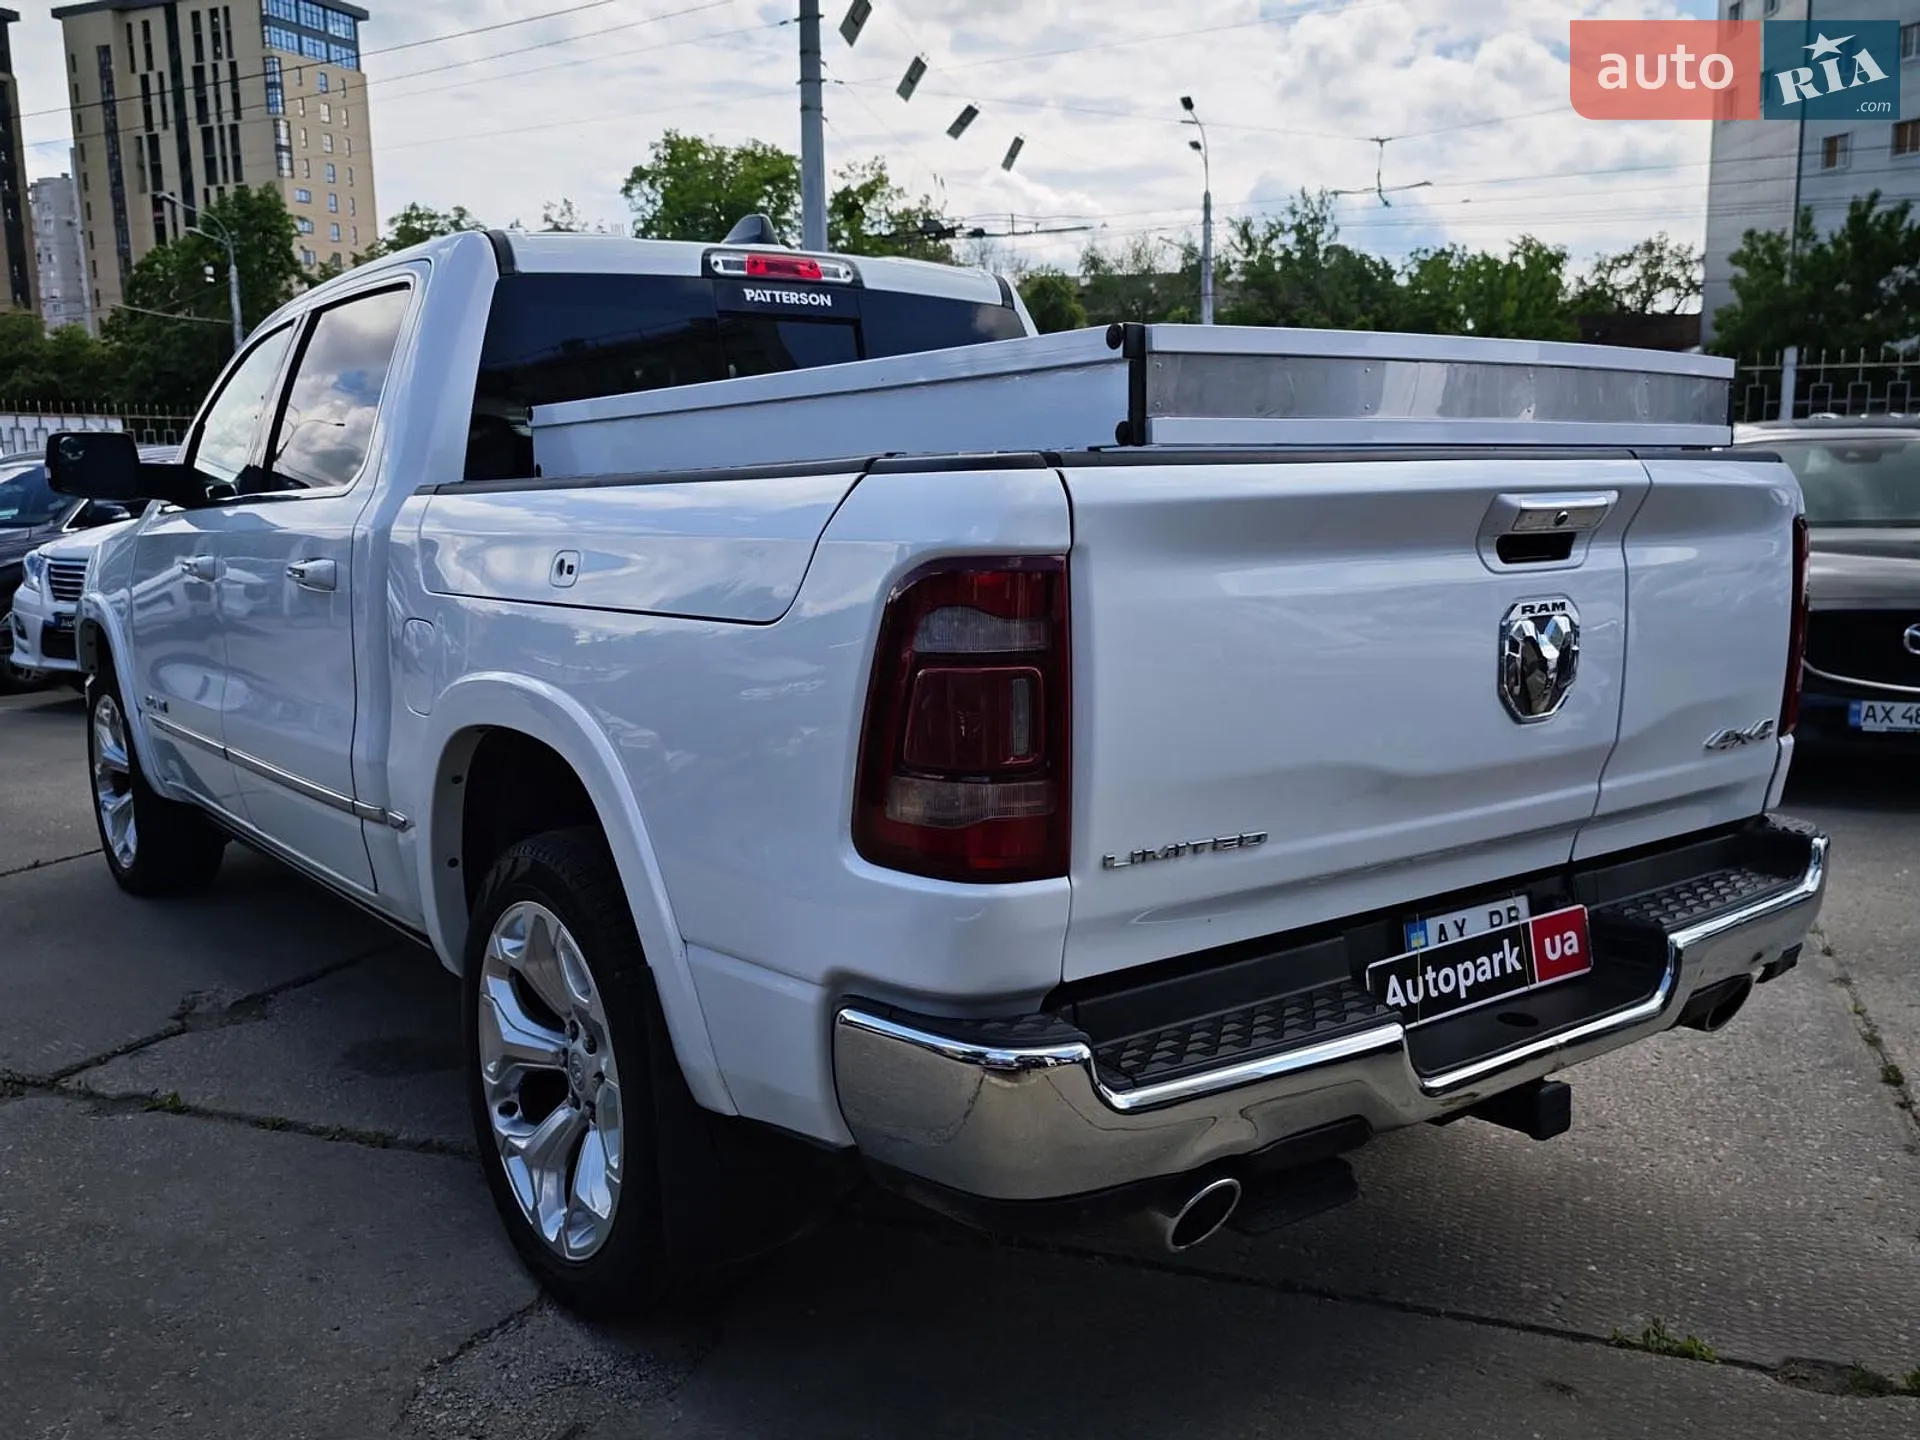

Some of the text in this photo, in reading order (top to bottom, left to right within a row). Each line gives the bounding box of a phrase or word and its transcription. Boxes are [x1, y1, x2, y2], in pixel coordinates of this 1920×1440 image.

[743, 288, 832, 307] PATTERSON
[1521, 602, 1566, 615] RAM
[1863, 704, 1895, 724] AX
[1102, 831, 1269, 870] LIMITED
[1386, 930, 1580, 1008] Autopark ua
